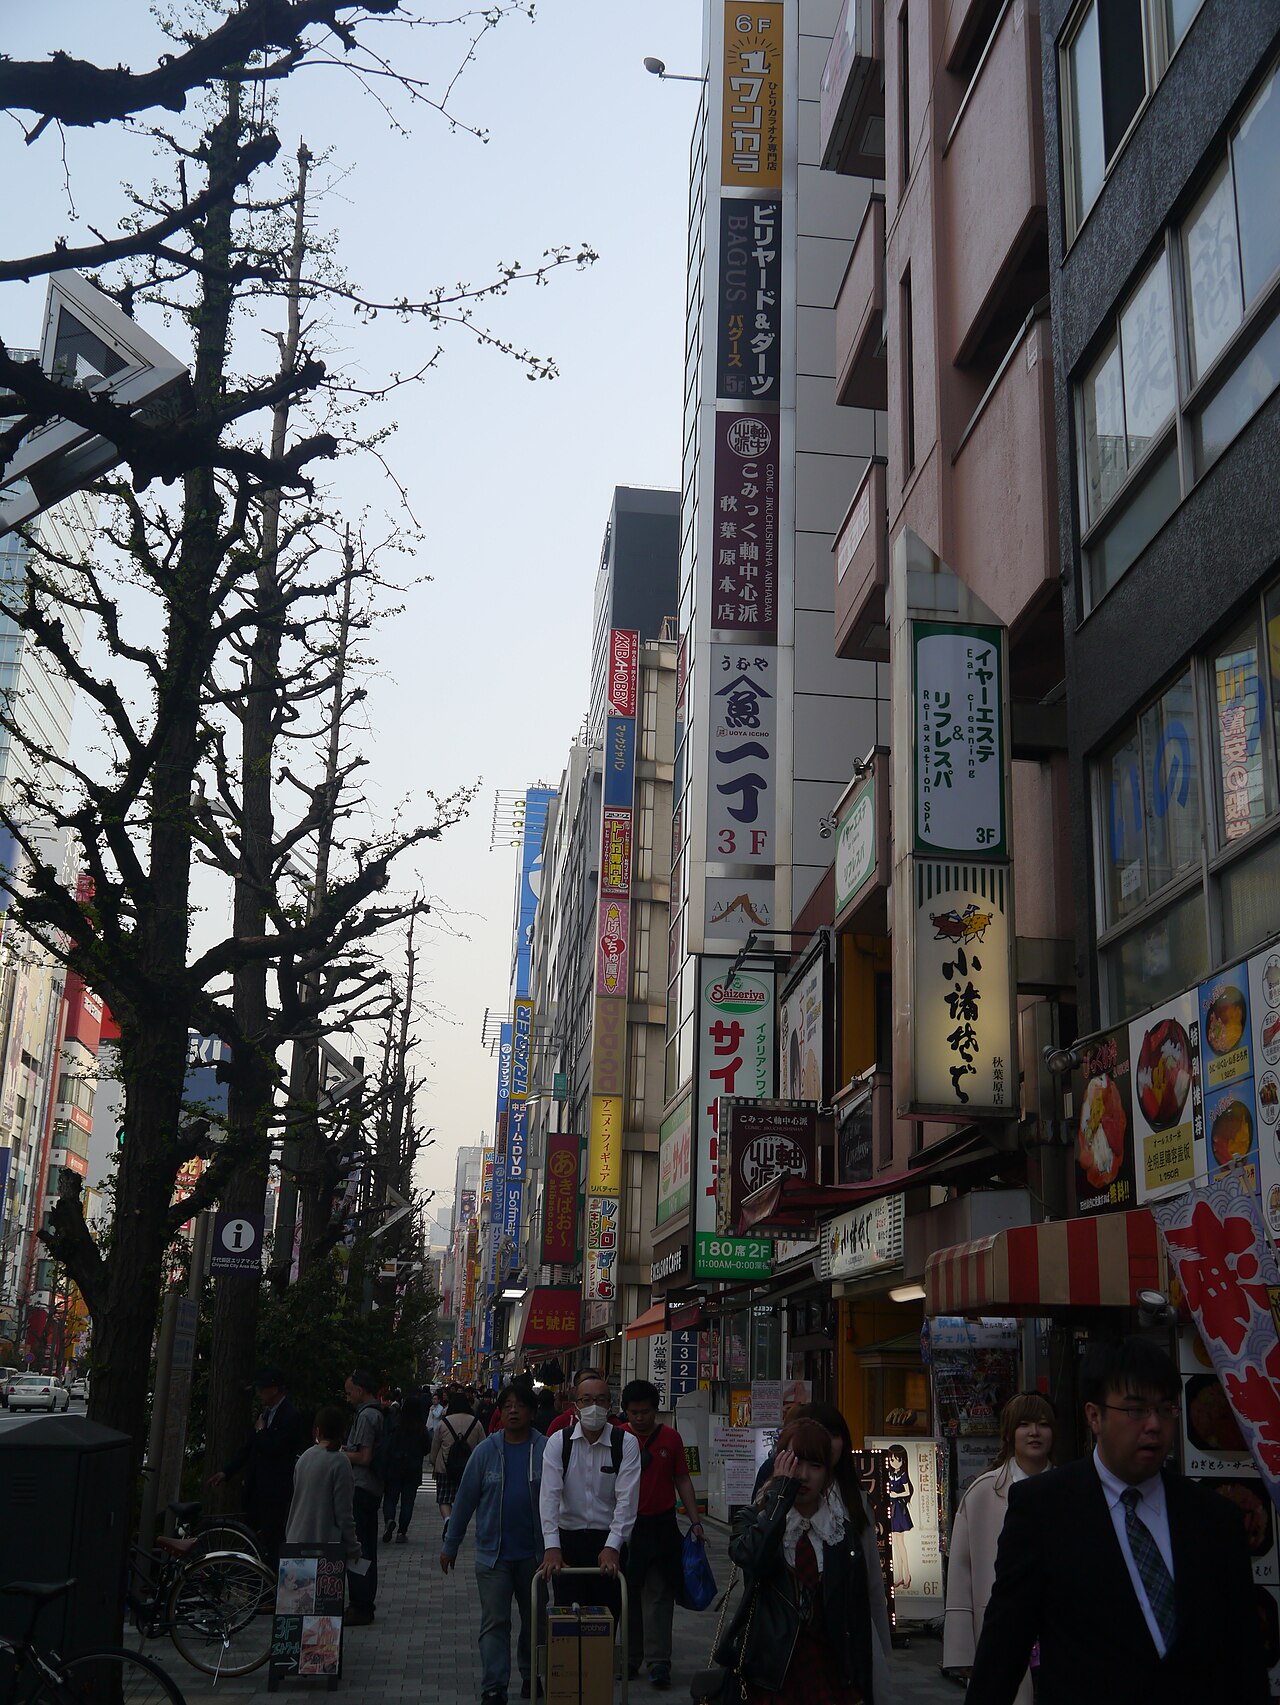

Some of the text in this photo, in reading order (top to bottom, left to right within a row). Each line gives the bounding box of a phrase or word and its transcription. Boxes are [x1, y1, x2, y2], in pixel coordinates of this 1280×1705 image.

[735, 14, 771, 34] 6F
[766, 82, 778, 171] ひとりカラオケ専門店
[750, 204, 777, 396] ビリヤード&ダーツ
[725, 375, 745, 393] 5F
[765, 463, 775, 493] COMIC
[738, 463, 759, 623] こみっく軸中心派
[717, 495, 738, 621] 秋葉原本店
[763, 571, 773, 623] AKIHABARA
[608, 707, 618, 716] 6F
[966, 648, 976, 779] Ear cleaning
[975, 649, 995, 763] イヤーエステ
[933, 691, 954, 788] リフレスパ
[923, 801, 931, 833] SPA
[976, 827, 995, 844] 3F
[711, 984, 765, 1003] Saizeriya
[992, 1056, 1004, 1105] 秋葉原店
[739, 1114, 808, 1127] こみっく軸中心派
[600, 1099, 612, 1183] アニメ・フィギュア
[590, 1185, 618, 1193] リバティー
[749, 1243, 769, 1258] 2F
[680, 1331, 690, 1343] 4
[680, 1347, 689, 1359] 3
[679, 1364, 689, 1376] 2
[679, 1380, 687, 1392] 1
[923, 1581, 939, 1596] 6F
